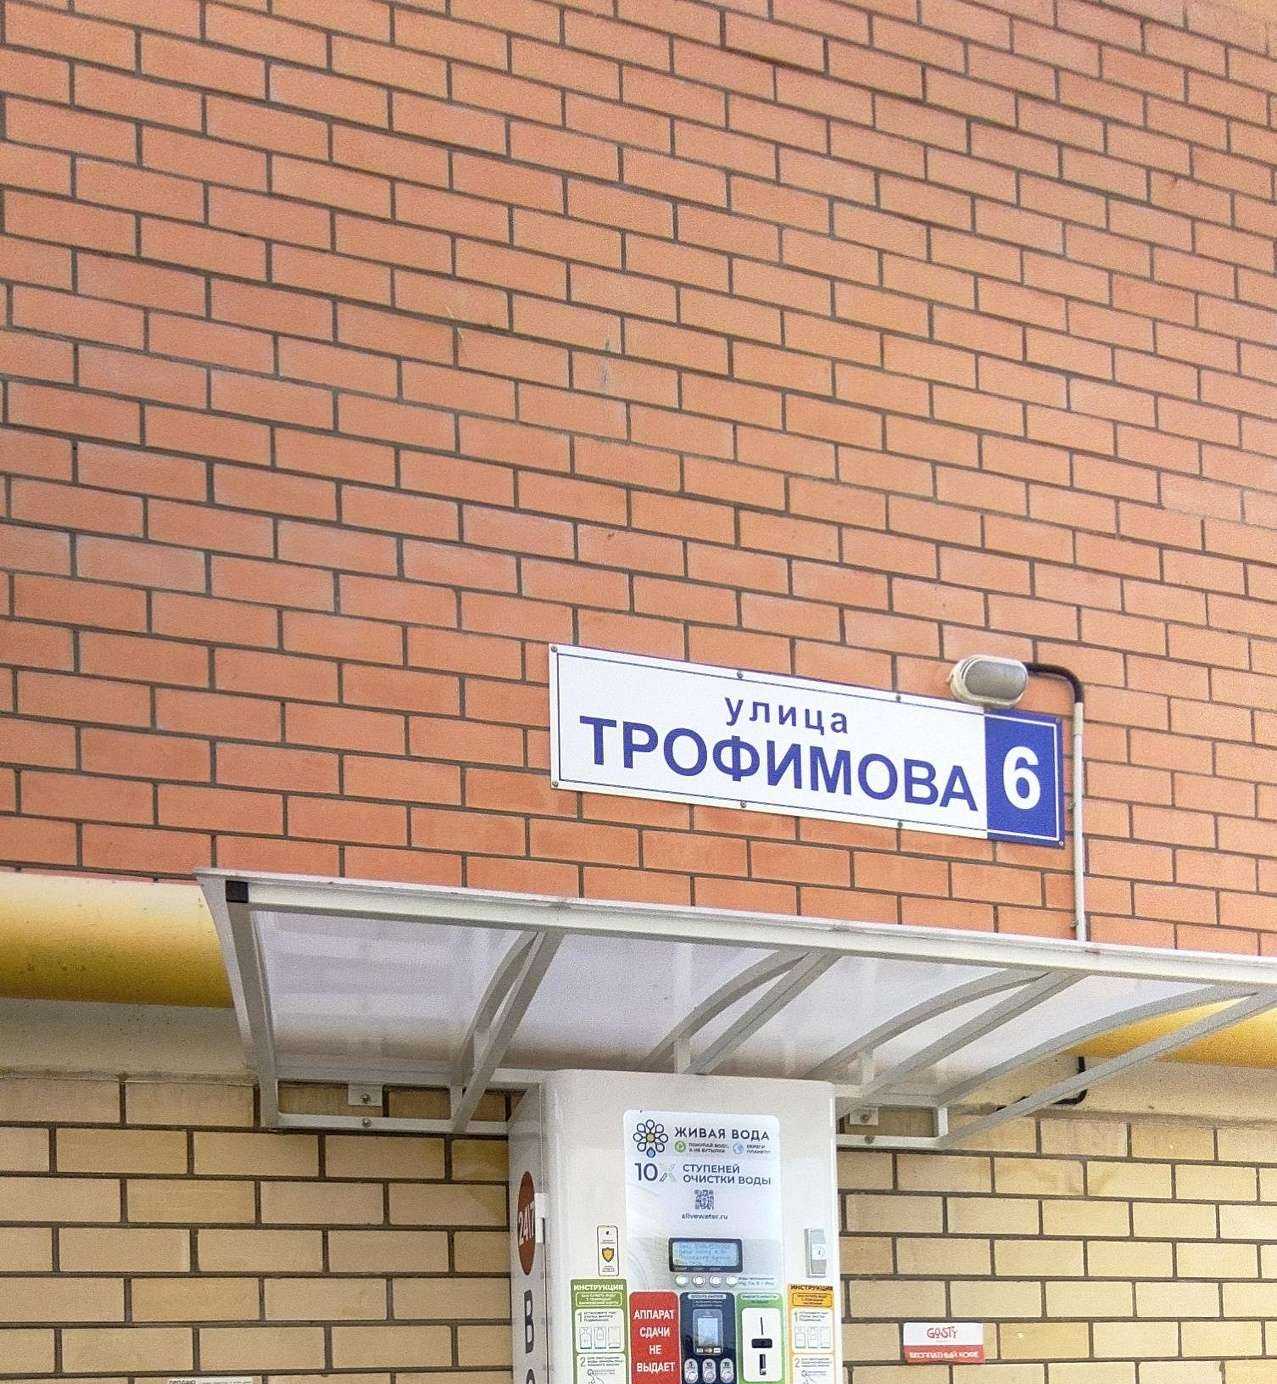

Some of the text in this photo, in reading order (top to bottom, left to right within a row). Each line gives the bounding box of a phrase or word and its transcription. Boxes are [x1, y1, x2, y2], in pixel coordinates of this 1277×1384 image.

[725, 696, 848, 735] улица
[579, 715, 977, 812] ТРОФИМОВА
[1003, 746, 1041, 810] 6
[674, 1127, 770, 1141] ЖИВАЯ ВОДА
[683, 1163, 741, 1175] СТУПЕНЕЙ
[683, 1174, 771, 1186] ОЧИСТКИ ВОДЫ
[574, 1284, 624, 1292] ИНСТРУКЦИЯ
[634, 1309, 675, 1320] АППАРАТ
[640, 1327, 671, 1340] СДАЧИ
[649, 1344, 662, 1355] НЕ
[637, 1361, 675, 1374] ВЫДАЕТ
